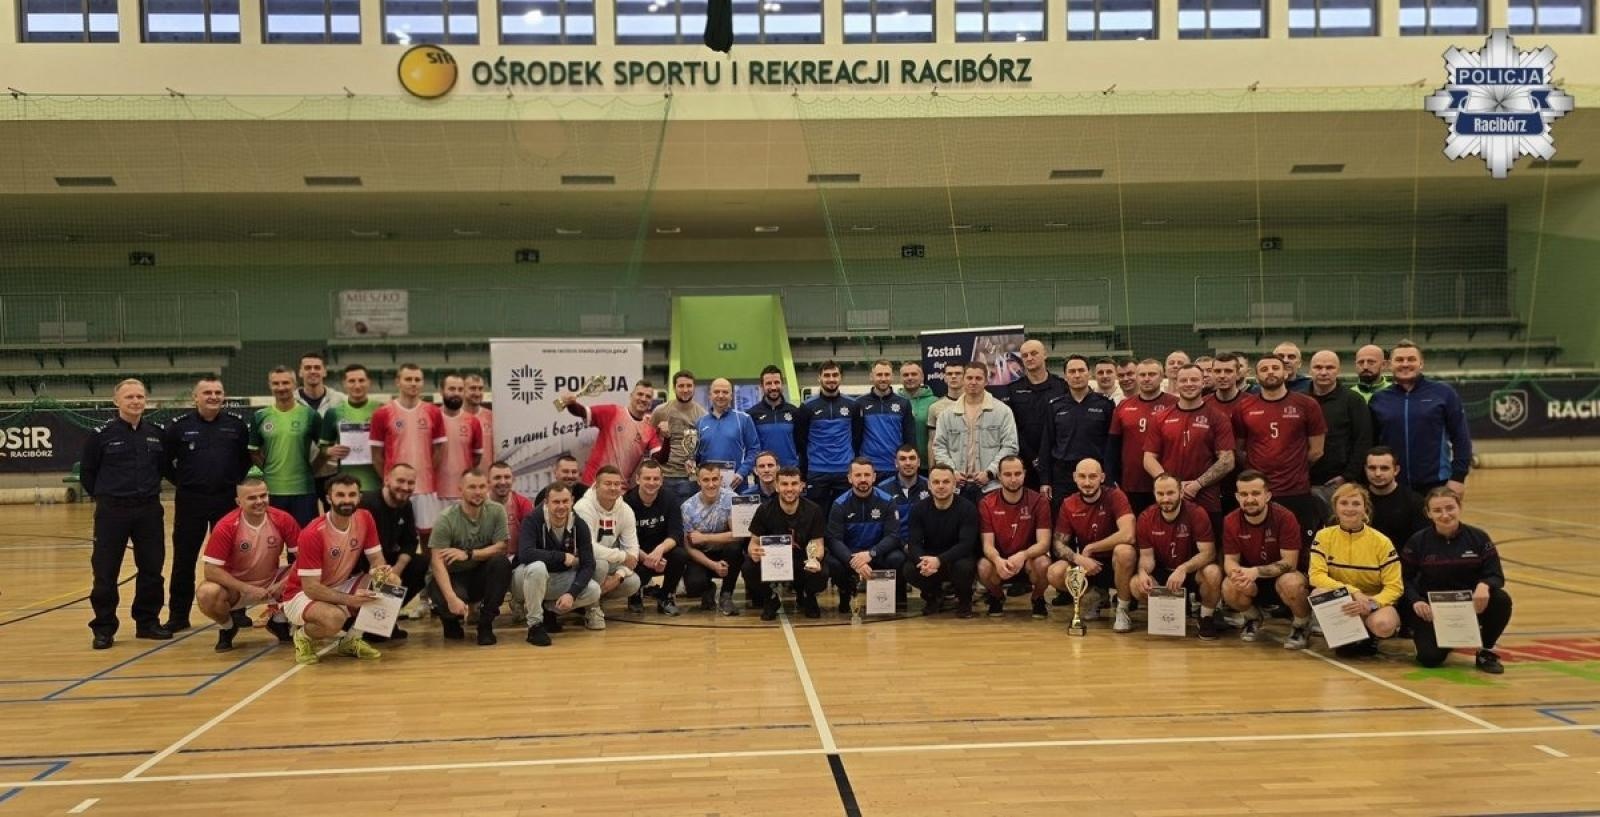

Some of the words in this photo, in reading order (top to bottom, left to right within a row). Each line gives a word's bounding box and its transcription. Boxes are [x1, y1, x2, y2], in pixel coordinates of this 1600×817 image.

[471, 56, 603, 86] OŚRODEK
[614, 60, 723, 86] SPORTU
[732, 61, 737, 85] I
[749, 59, 889, 85] REKREACJI
[901, 54, 1032, 83] RACIBÓRZ
[927, 345, 962, 357] Zostań
[555, 375, 628, 392] POJA
[1548, 400, 1600, 418] RACI
[514, 427, 548, 444] nami
[553, 421, 588, 437] bezp
[1139, 417, 1146, 432] 9
[1270, 421, 1279, 438] 5
[10, 449, 53, 458] RACIBÓRZ
[1011, 523, 1018, 538] 7
[1170, 542, 1176, 557] 2
